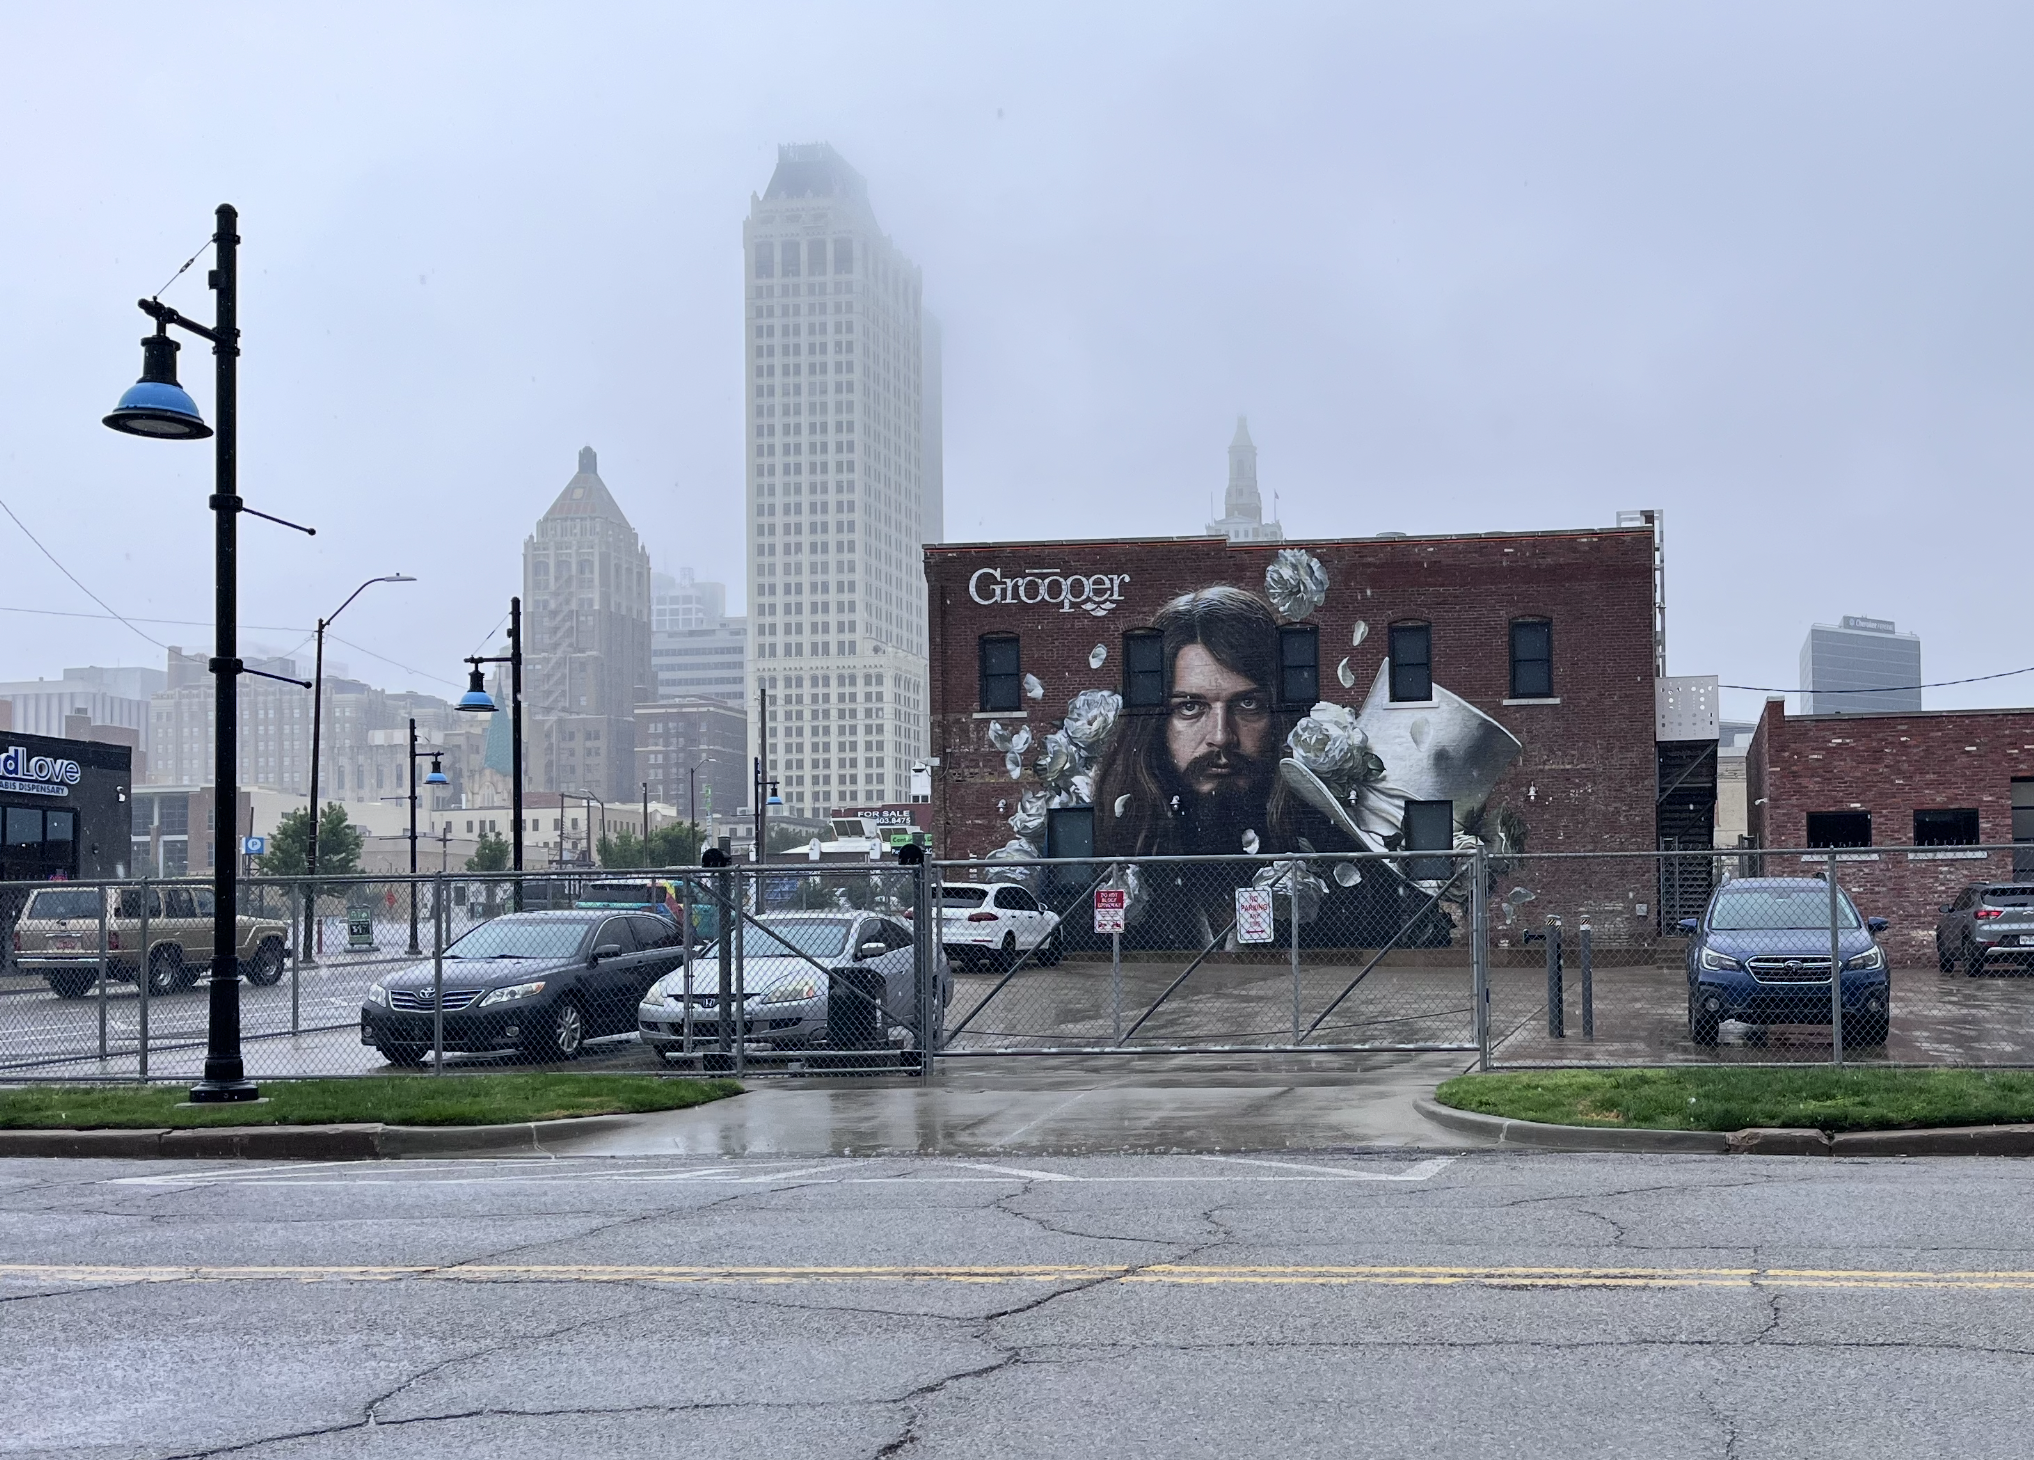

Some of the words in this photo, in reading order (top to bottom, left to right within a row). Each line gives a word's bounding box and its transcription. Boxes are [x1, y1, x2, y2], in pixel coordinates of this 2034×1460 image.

[969, 568, 1131, 612] Grooper
[0, 746, 80, 784] dLove
[19, 783, 65, 794] DISPENSARY
